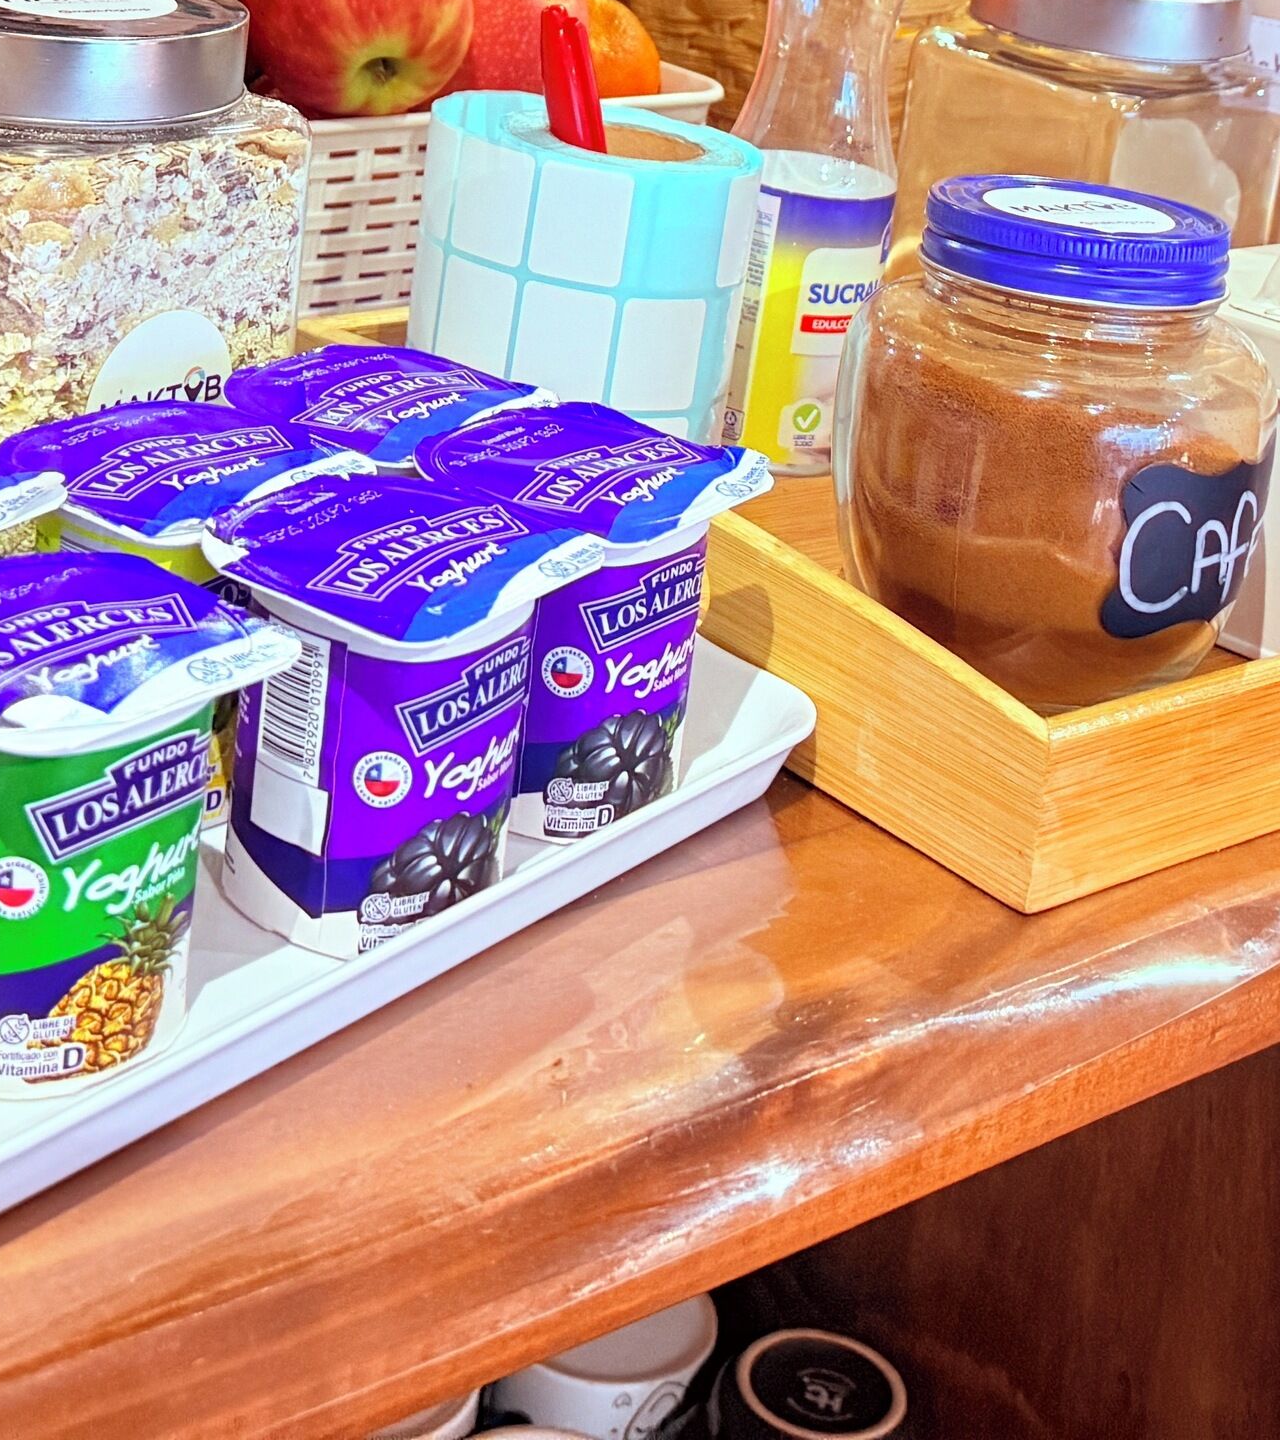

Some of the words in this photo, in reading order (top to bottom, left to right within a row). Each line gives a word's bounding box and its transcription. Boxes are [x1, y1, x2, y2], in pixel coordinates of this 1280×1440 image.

[314, 396, 362, 426] LOS
[357, 373, 468, 408] ALERCES
[336, 374, 393, 398] FUNDO
[376, 392, 468, 423] Yoghurt
[88, 463, 147, 492] LOS
[146, 431, 273, 472] ALERCES
[119, 438, 187, 458] FUNDO
[546, 450, 600, 472] FUNDO
[160, 456, 267, 492] Yoghurt
[535, 471, 583, 505] LOS
[579, 440, 680, 483] ALERCES
[599, 466, 687, 507] Yoghurt
[333, 553, 391, 592] LOS
[388, 513, 504, 566] ALERCES
[354, 524, 419, 552] FUNDO
[406, 540, 510, 594] Yoghurt
[651, 561, 693, 588] FUNDO
[15, 605, 175, 658] ALERCES
[598, 596, 648, 637] LOS
[26, 634, 162, 692] Yoghurt
[474, 645, 519, 681] FUNDO
[417, 696, 471, 738] LOS
[304, 712, 320, 767] 802920
[122, 740, 189, 781] FUNDO
[205, 789, 222, 812] D
[575, 791, 604, 800] GLUTEN
[576, 783, 597, 792] LIBRE
[51, 800, 121, 842] LOS
[546, 816, 595, 830] Vitamina
[597, 807, 612, 828] D
[134, 879, 167, 905] Sabor
[32, 1019, 59, 1031] LIBRE
[32, 1028, 69, 1040] GLUTEN
[62, 1046, 84, 1070] D
